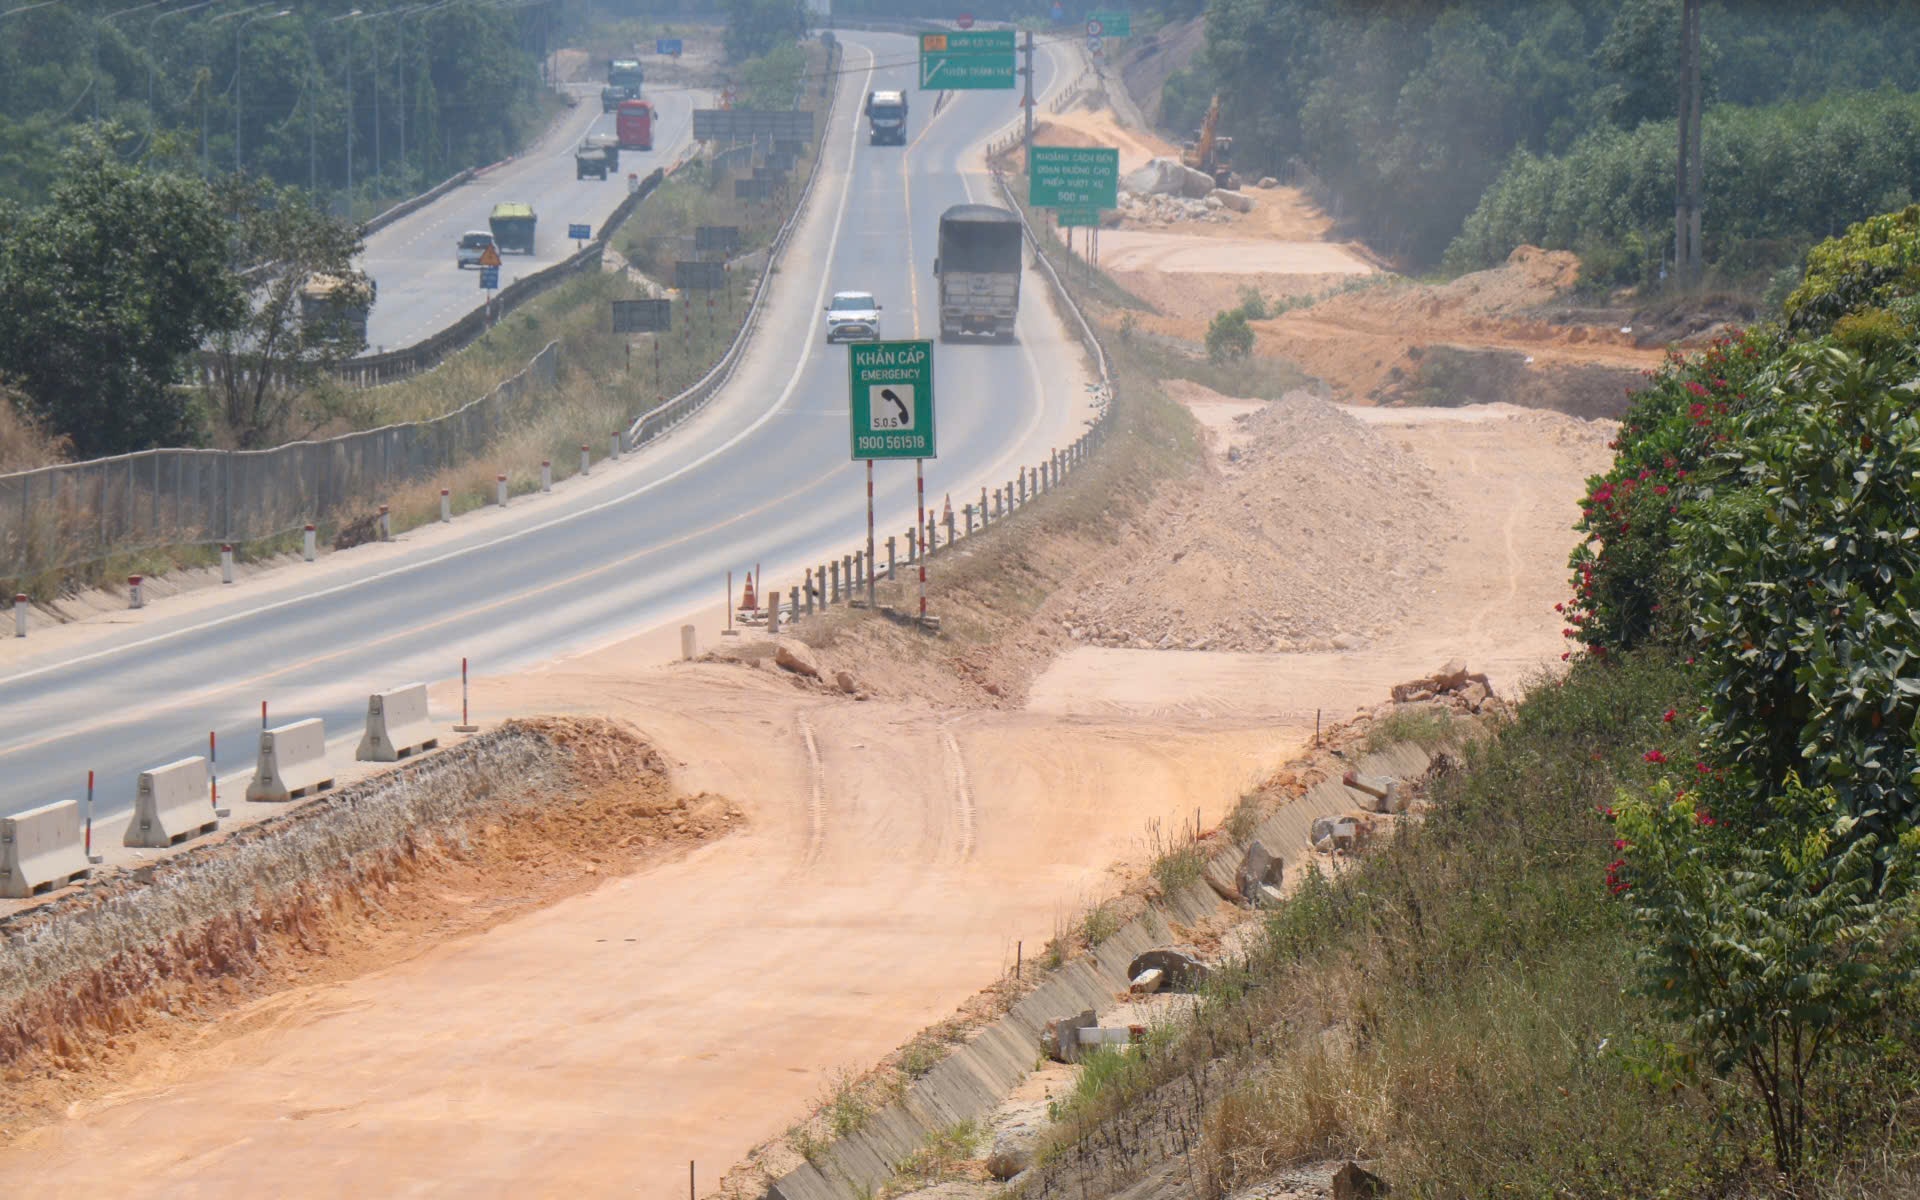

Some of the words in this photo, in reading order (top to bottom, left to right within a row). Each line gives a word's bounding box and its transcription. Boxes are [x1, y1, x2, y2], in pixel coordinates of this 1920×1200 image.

[1057, 191, 1076, 202] 500
[1079, 194, 1089, 202] m
[856, 345, 895, 366] KHẨN
[898, 345, 925, 364] CẤP
[861, 368, 921, 380] EMERGENCY
[873, 417, 898, 428] S.O.S
[858, 436, 884, 449] 1900
[886, 435, 925, 449] 561518
